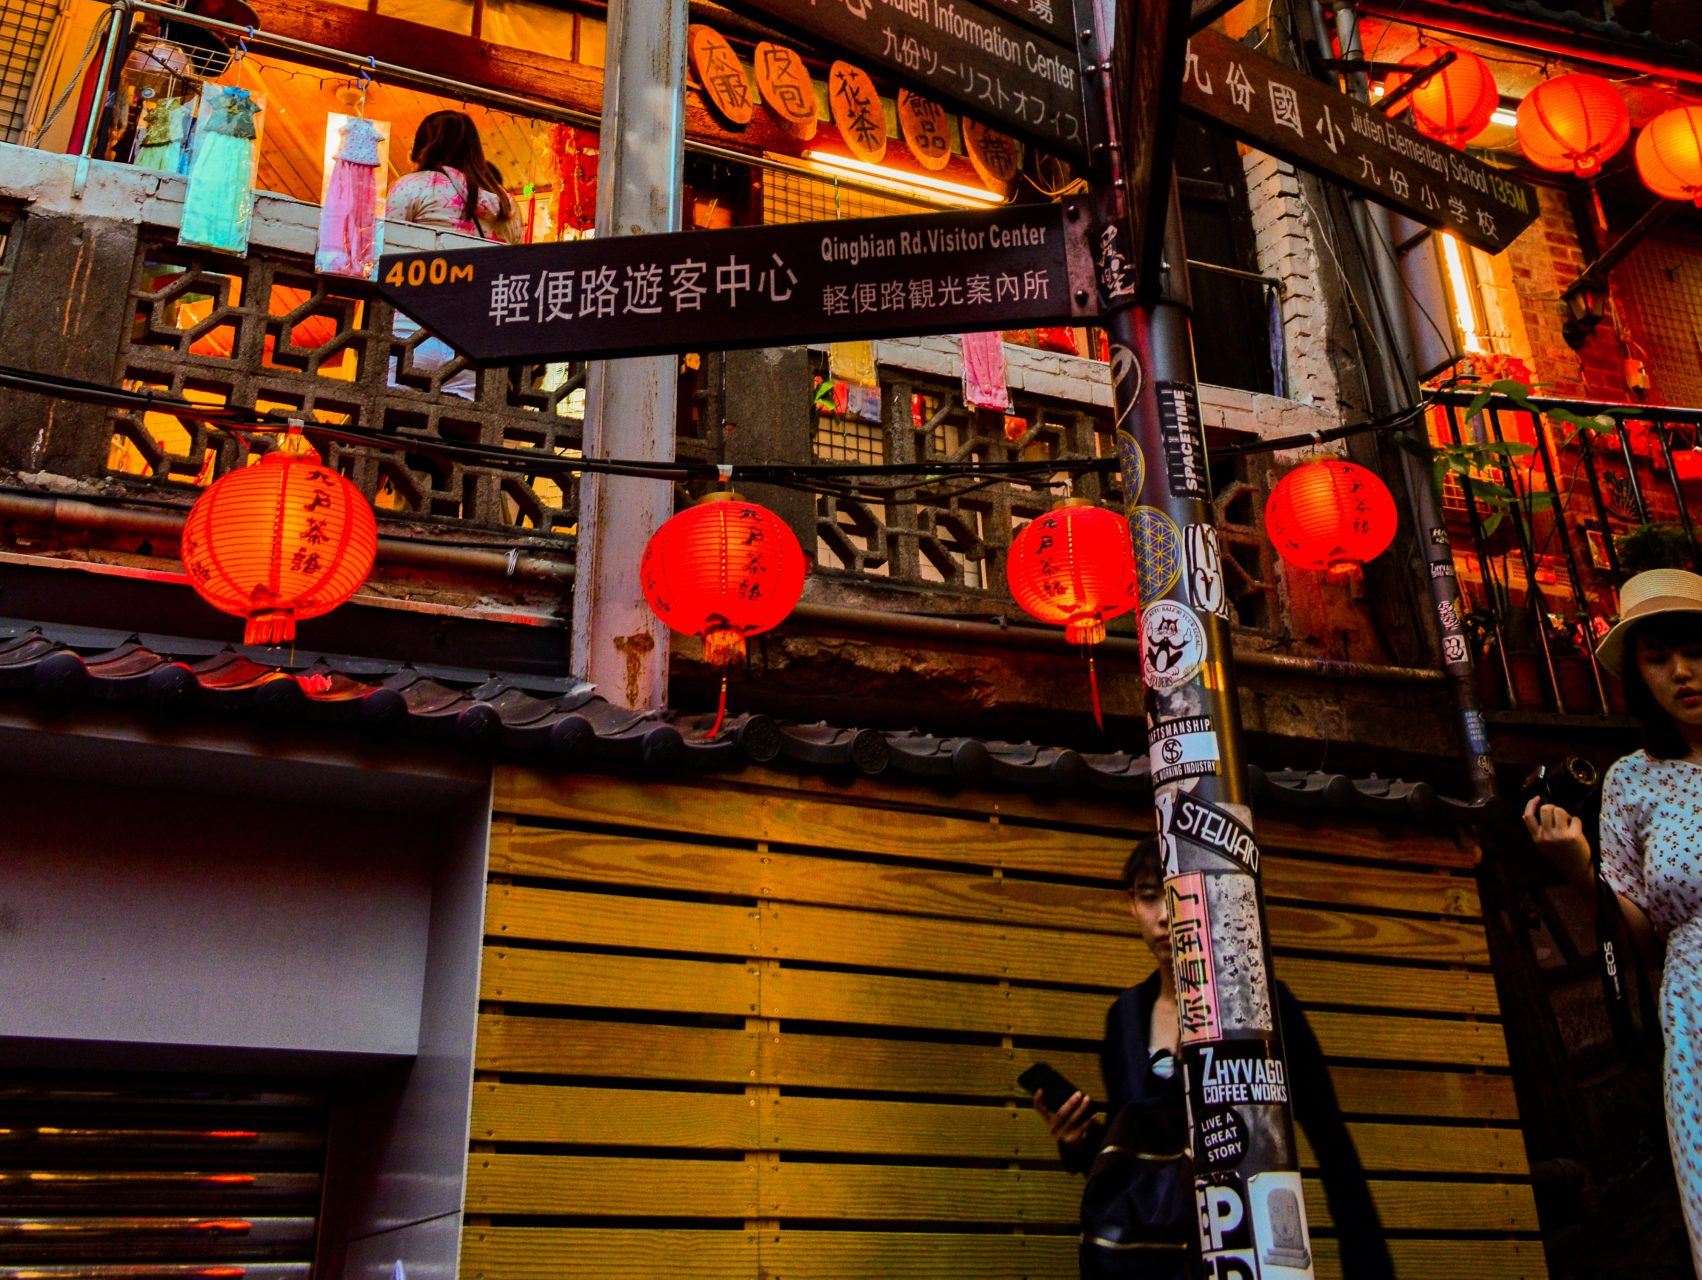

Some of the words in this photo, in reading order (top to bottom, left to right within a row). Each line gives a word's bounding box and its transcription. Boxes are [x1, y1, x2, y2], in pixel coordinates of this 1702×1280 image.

[763, 44, 815, 119] 皮包
[883, 26, 1082, 144] 九份ツーリストオフィス
[1025, 41, 1075, 92] Center
[835, 71, 880, 152] 花茶
[1183, 38, 1346, 155] 九份國小
[1350, 105, 1386, 146] Jiufen
[1387, 121, 1450, 183] Elementary
[1450, 154, 1489, 195] School
[1488, 174, 1528, 215] 135M
[1359, 154, 1499, 241] 九份小学校
[821, 234, 895, 266] Qingbian
[989, 224, 1046, 248] Center
[385, 257, 474, 288] 400M
[488, 252, 798, 326] 輕便路遊客中心
[1173, 389, 1198, 491] SPACETIME
[1160, 764, 1183, 782] WORKING
[1184, 760, 1217, 776] INDUSTRY
[1168, 885, 1213, 1034] 你看到了
[1603, 941, 1616, 976] EOS
[1199, 1047, 1285, 1087] ZHYVAGO
[1203, 1083, 1248, 1104] COFFEE
[1250, 1084, 1287, 1102] WORKS
[1201, 1115, 1223, 1133] LIVE
[1226, 1112, 1234, 1124] A
[1204, 1126, 1238, 1148] GREAT
[1207, 1141, 1242, 1163] STORY
